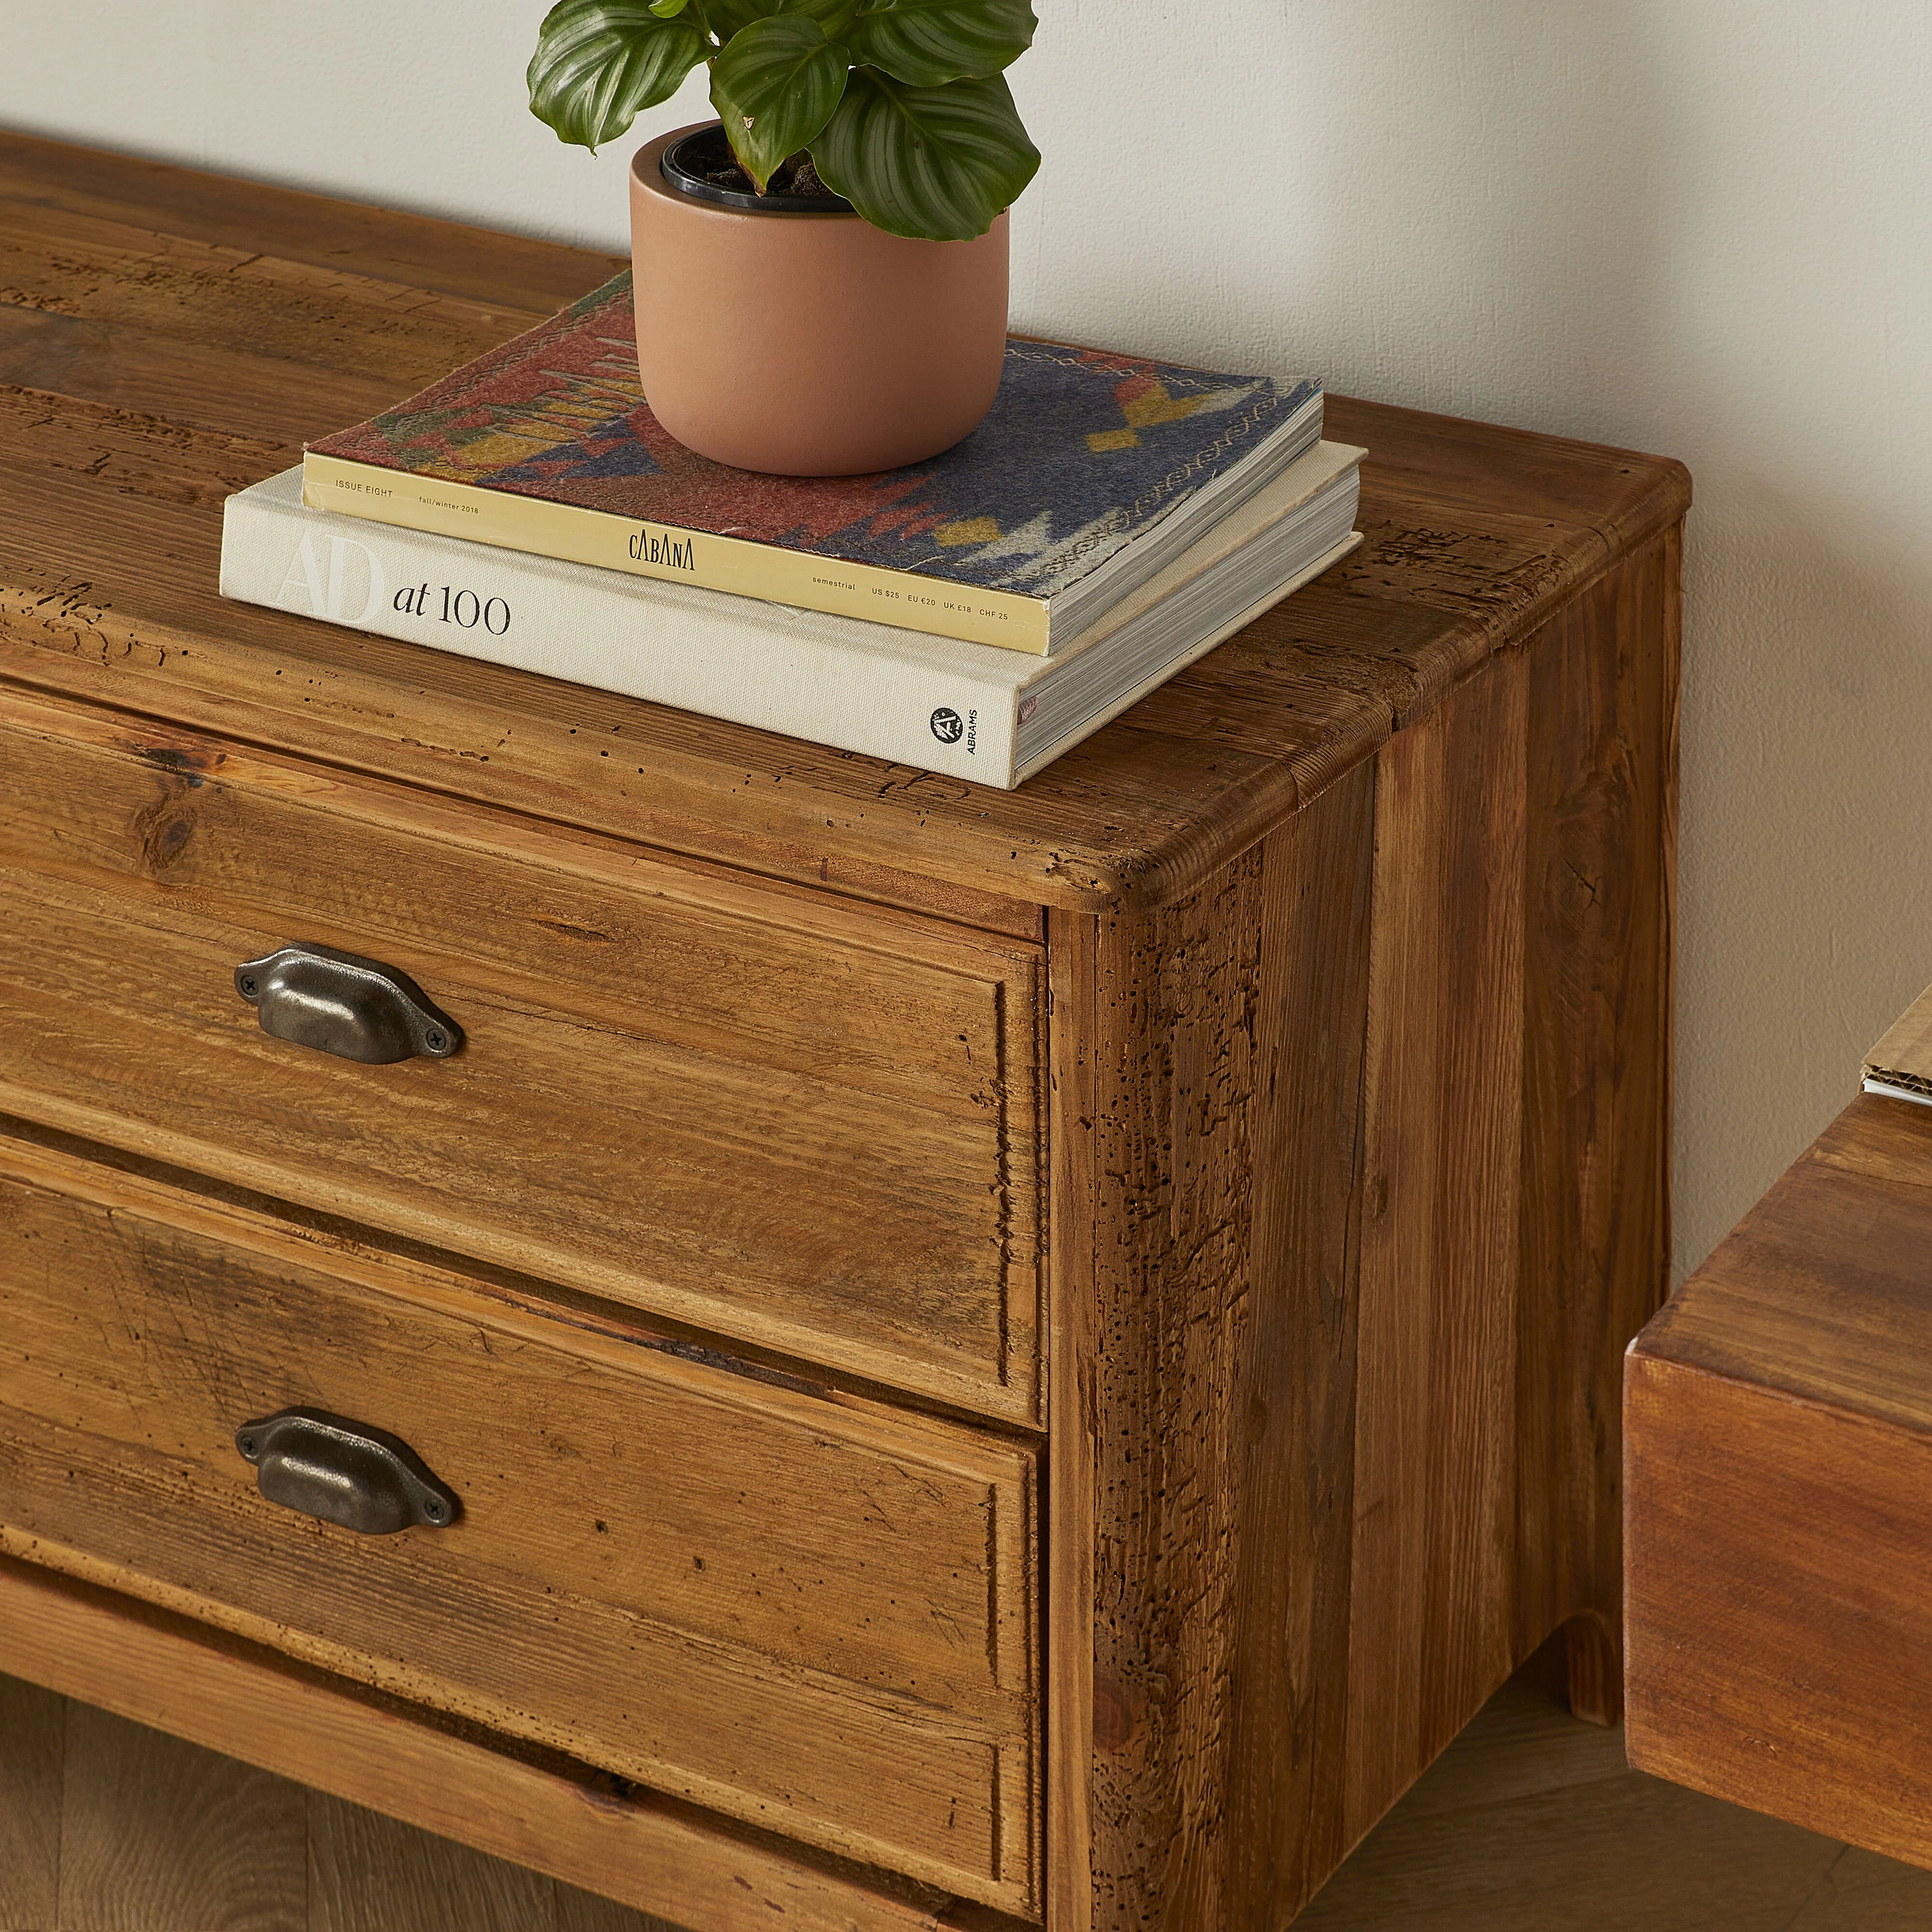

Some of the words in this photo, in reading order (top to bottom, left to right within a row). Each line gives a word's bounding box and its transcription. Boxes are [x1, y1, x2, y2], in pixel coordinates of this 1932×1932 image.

[336, 480, 363, 492] ISSUE
[366, 485, 393, 498] EIGHT
[419, 496, 459, 510] fall/winter
[461, 505, 479, 514] 2018
[629, 528, 696, 571] CABANA
[268, 527, 385, 623] AD
[393, 582, 431, 616] at
[438, 585, 511, 635] 100
[812, 577, 855, 590] semestrial
[872, 587, 882, 596] US
[885, 590, 899, 599] $25
[908, 595, 918, 603] EU
[921, 597, 936, 606] €20
[944, 602, 955, 610] UK
[957, 605, 971, 613] £18
[980, 609, 996, 617] CHF
[967, 709, 978, 755] ABRAMS
